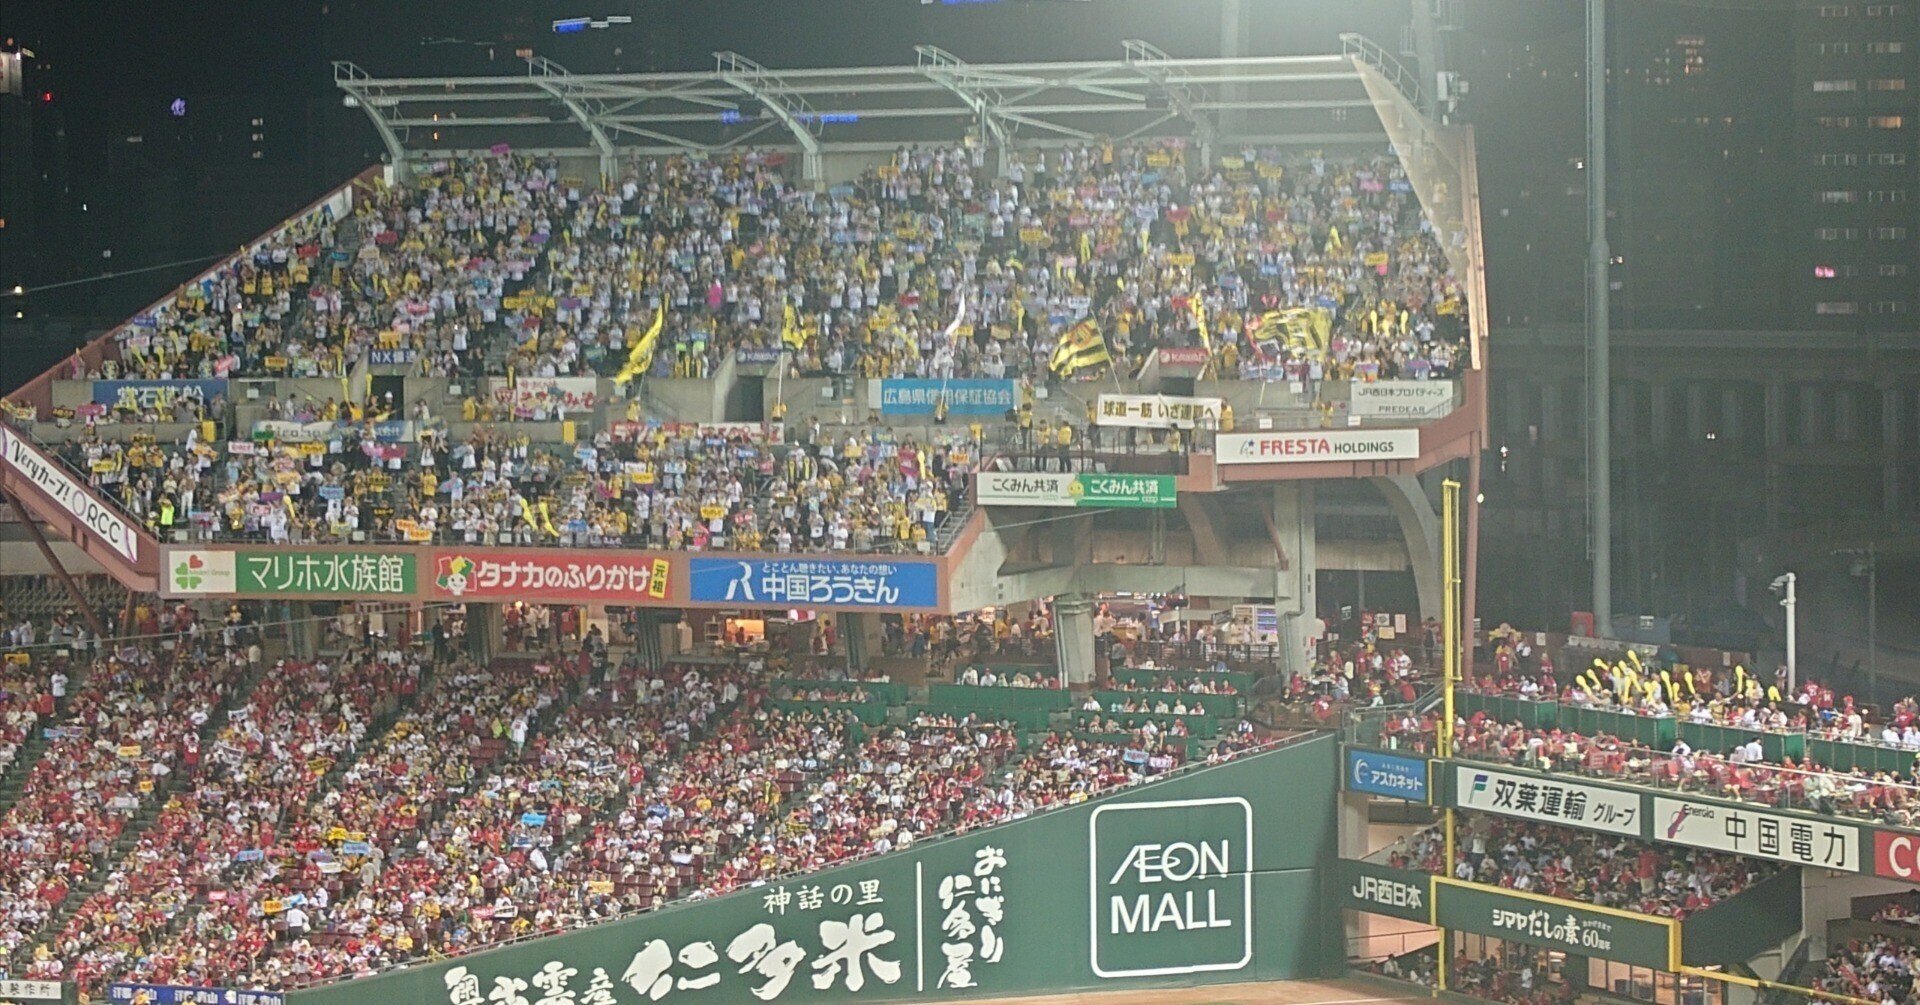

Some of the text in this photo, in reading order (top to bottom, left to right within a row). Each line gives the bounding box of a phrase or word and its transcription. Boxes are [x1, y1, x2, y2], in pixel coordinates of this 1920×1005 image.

[883, 387, 1011, 405] 広島県信用保証協会
[1378, 405, 1425, 414] PREDEAR
[1260, 438, 1394, 456] FRESTA HOLDINGS
[992, 478, 1059, 492] こくみん共済
[1090, 479, 1159, 495] こくみん共済
[86, 503, 121, 543] RCC
[248, 554, 404, 593] マリホ水族館
[478, 560, 651, 592] タナカのふりかけ
[653, 563, 668, 594] 元祖
[762, 573, 900, 604] 中国ろうきん
[1371, 770, 1423, 791] アスカネット
[1492, 779, 1636, 827] 双葉運輸 グループ
[1683, 803, 1715, 819] Energia
[1725, 812, 1846, 867] 中国電力
[1889, 836, 1920, 877] C
[764, 879, 884, 915] 神話の里
[974, 845, 1007, 963] おにぎり
[1352, 876, 1422, 909] JR西日本
[1111, 888, 1231, 934] MALL
[1492, 908, 1580, 945] シマヤだしの素
[621, 912, 902, 1001] 仁多米
